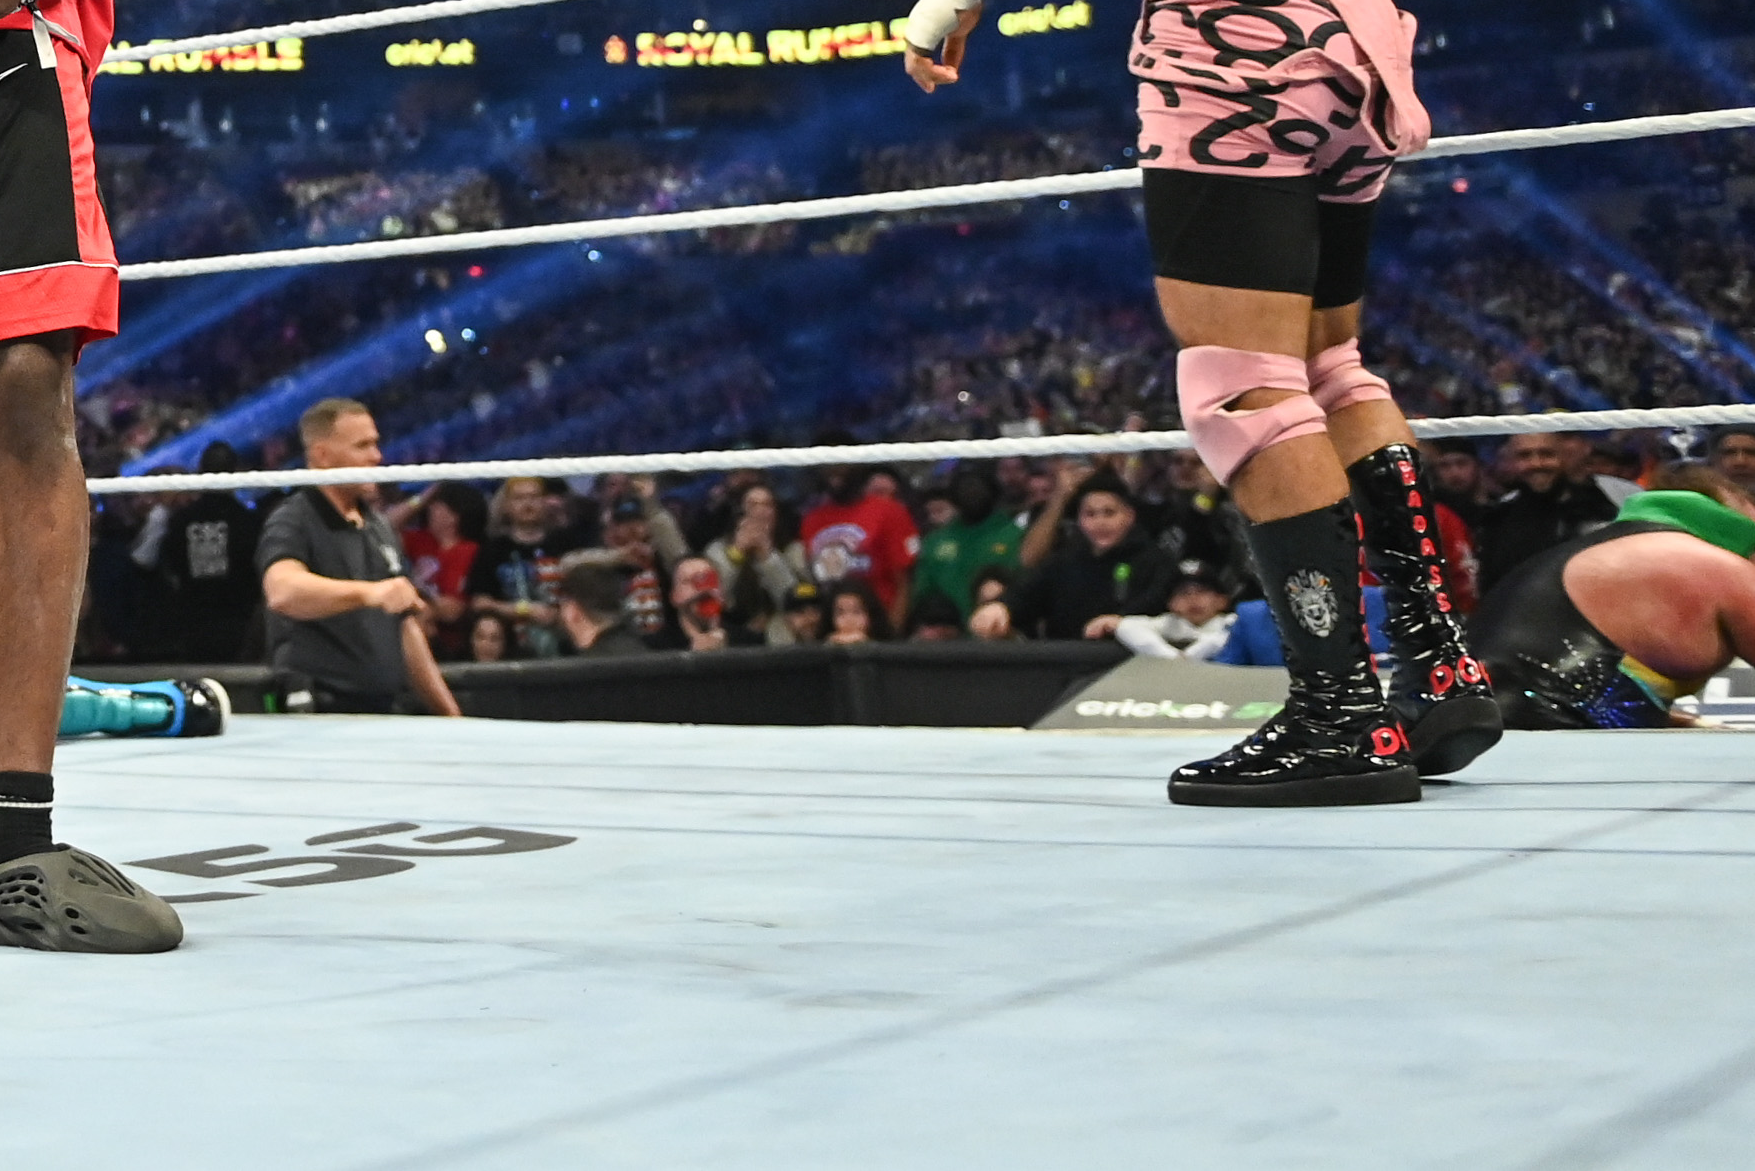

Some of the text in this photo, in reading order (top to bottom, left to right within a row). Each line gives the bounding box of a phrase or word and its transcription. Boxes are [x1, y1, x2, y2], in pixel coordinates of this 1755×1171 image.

[637, 31, 764, 66] ROYAL
[1398, 460, 1452, 613] BADASS
[1075, 698, 1230, 719] cricket
[122, 821, 578, 888] 5G
